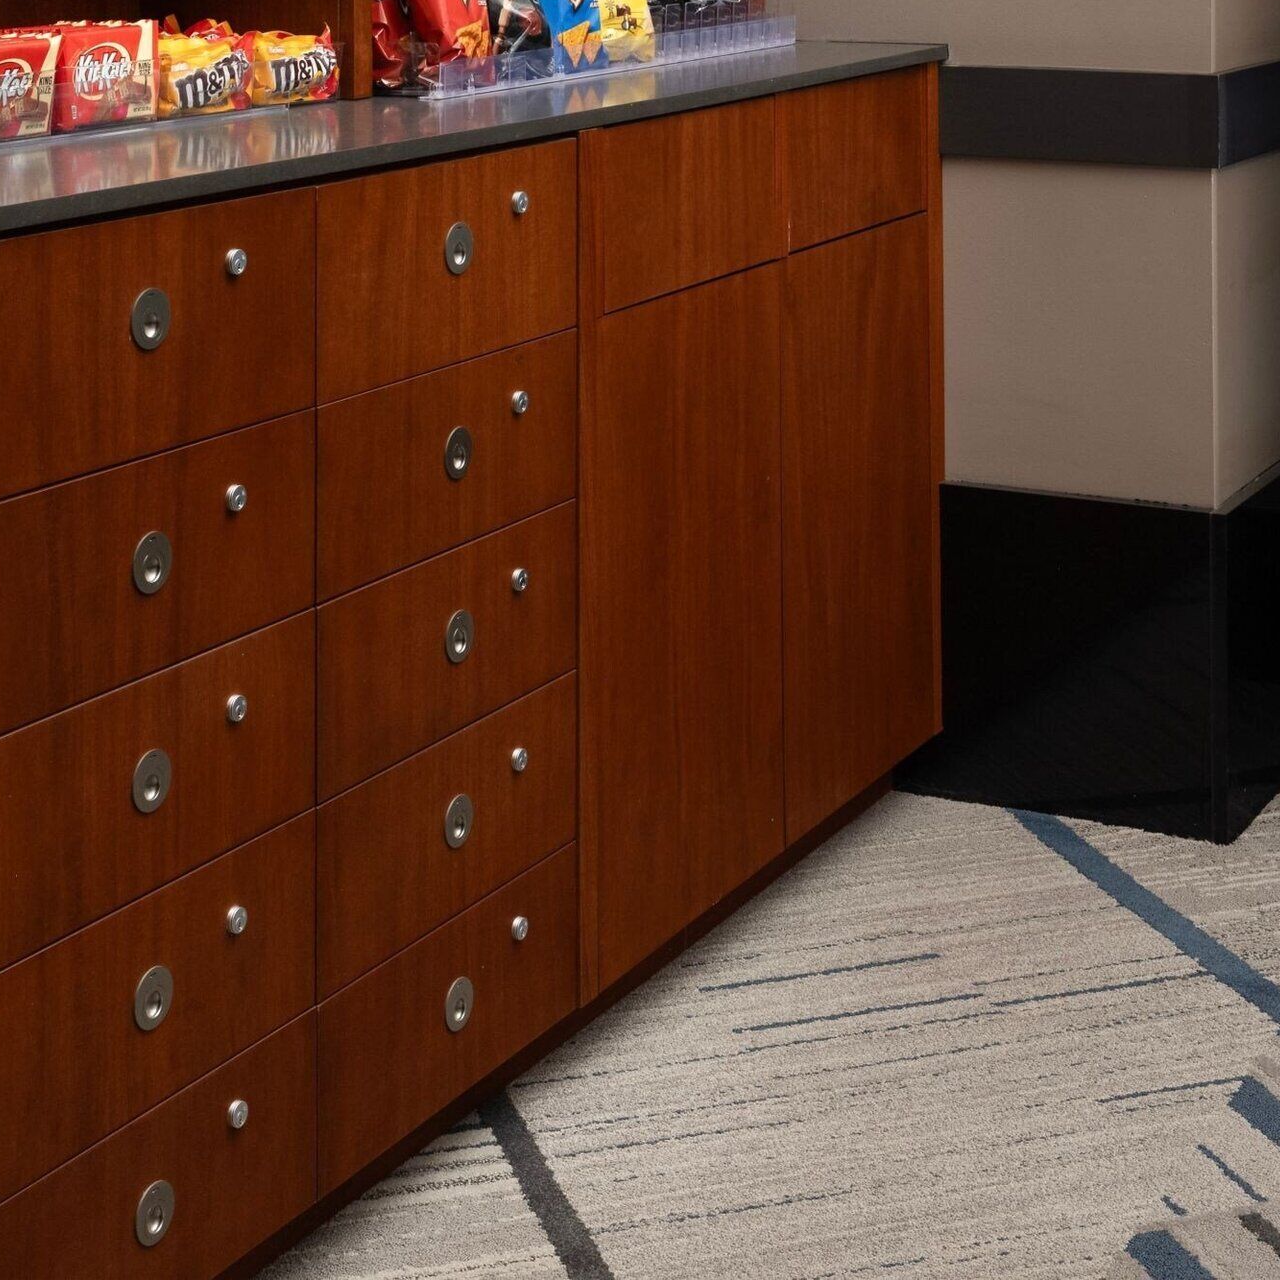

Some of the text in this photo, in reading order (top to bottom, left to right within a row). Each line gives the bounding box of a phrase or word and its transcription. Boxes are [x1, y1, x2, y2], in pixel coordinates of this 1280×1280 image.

[138, 60, 151, 69] KING
[38, 76, 53, 86] KING
[38, 85, 52, 95] SIZE
